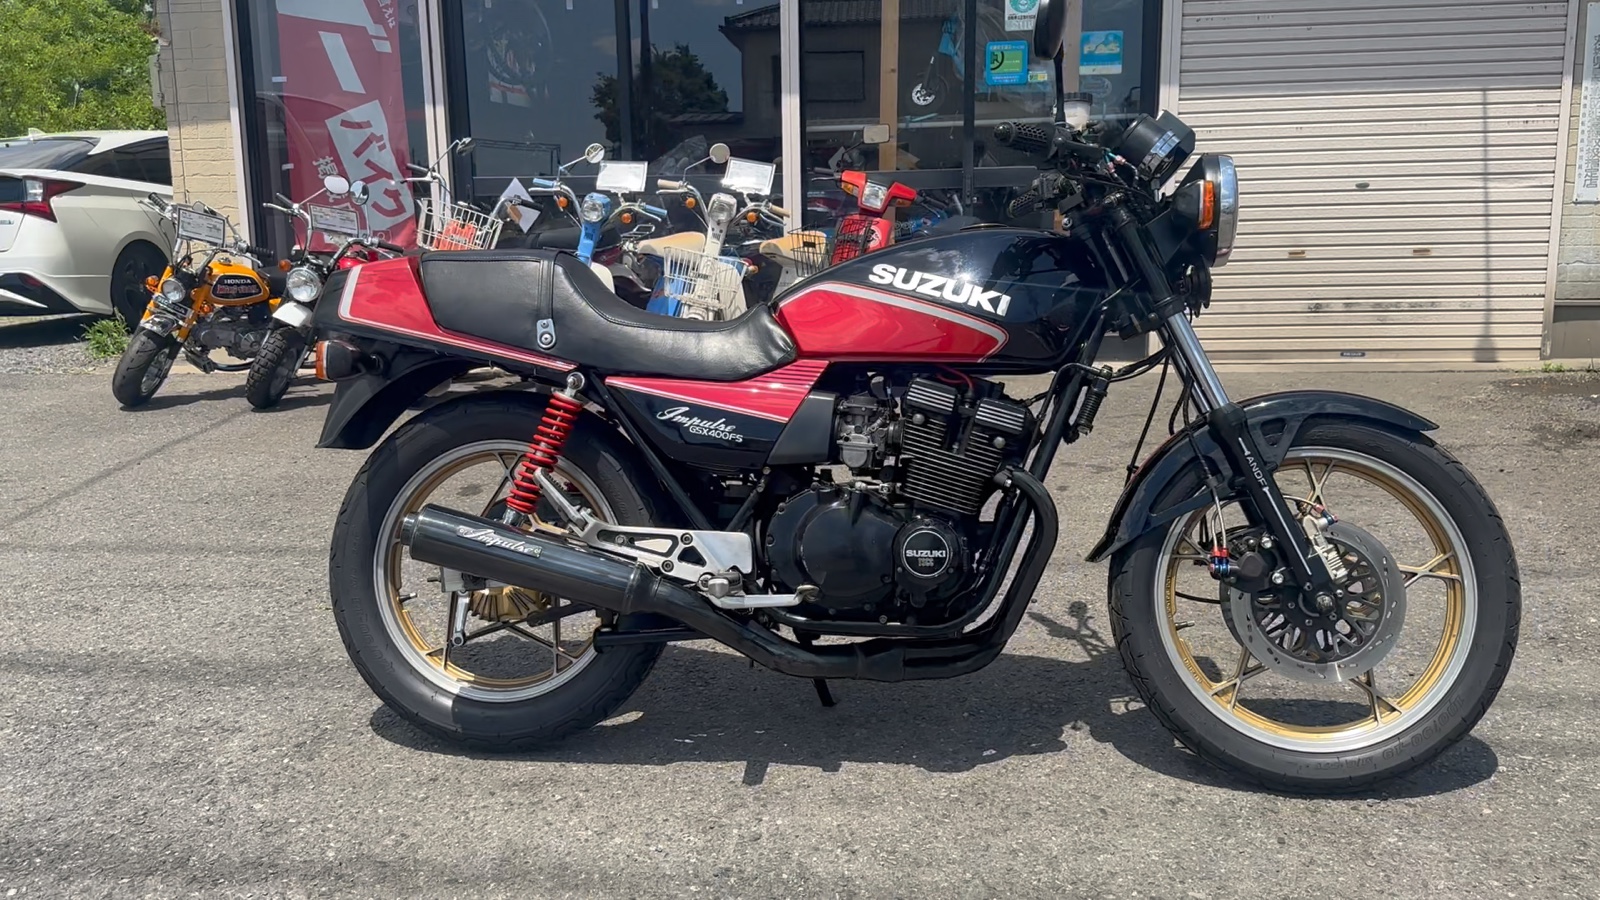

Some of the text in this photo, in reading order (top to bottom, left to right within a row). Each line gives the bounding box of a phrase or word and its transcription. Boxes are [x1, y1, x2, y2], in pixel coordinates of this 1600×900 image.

[868, 263, 1011, 316] SUZUKI
[656, 406, 736, 431] Impulse
[689, 425, 744, 443] GSX400FS
[1246, 456, 1268, 486] ANDF
[463, 528, 534, 554] Impulse
[905, 549, 946, 558] SUZUKI
